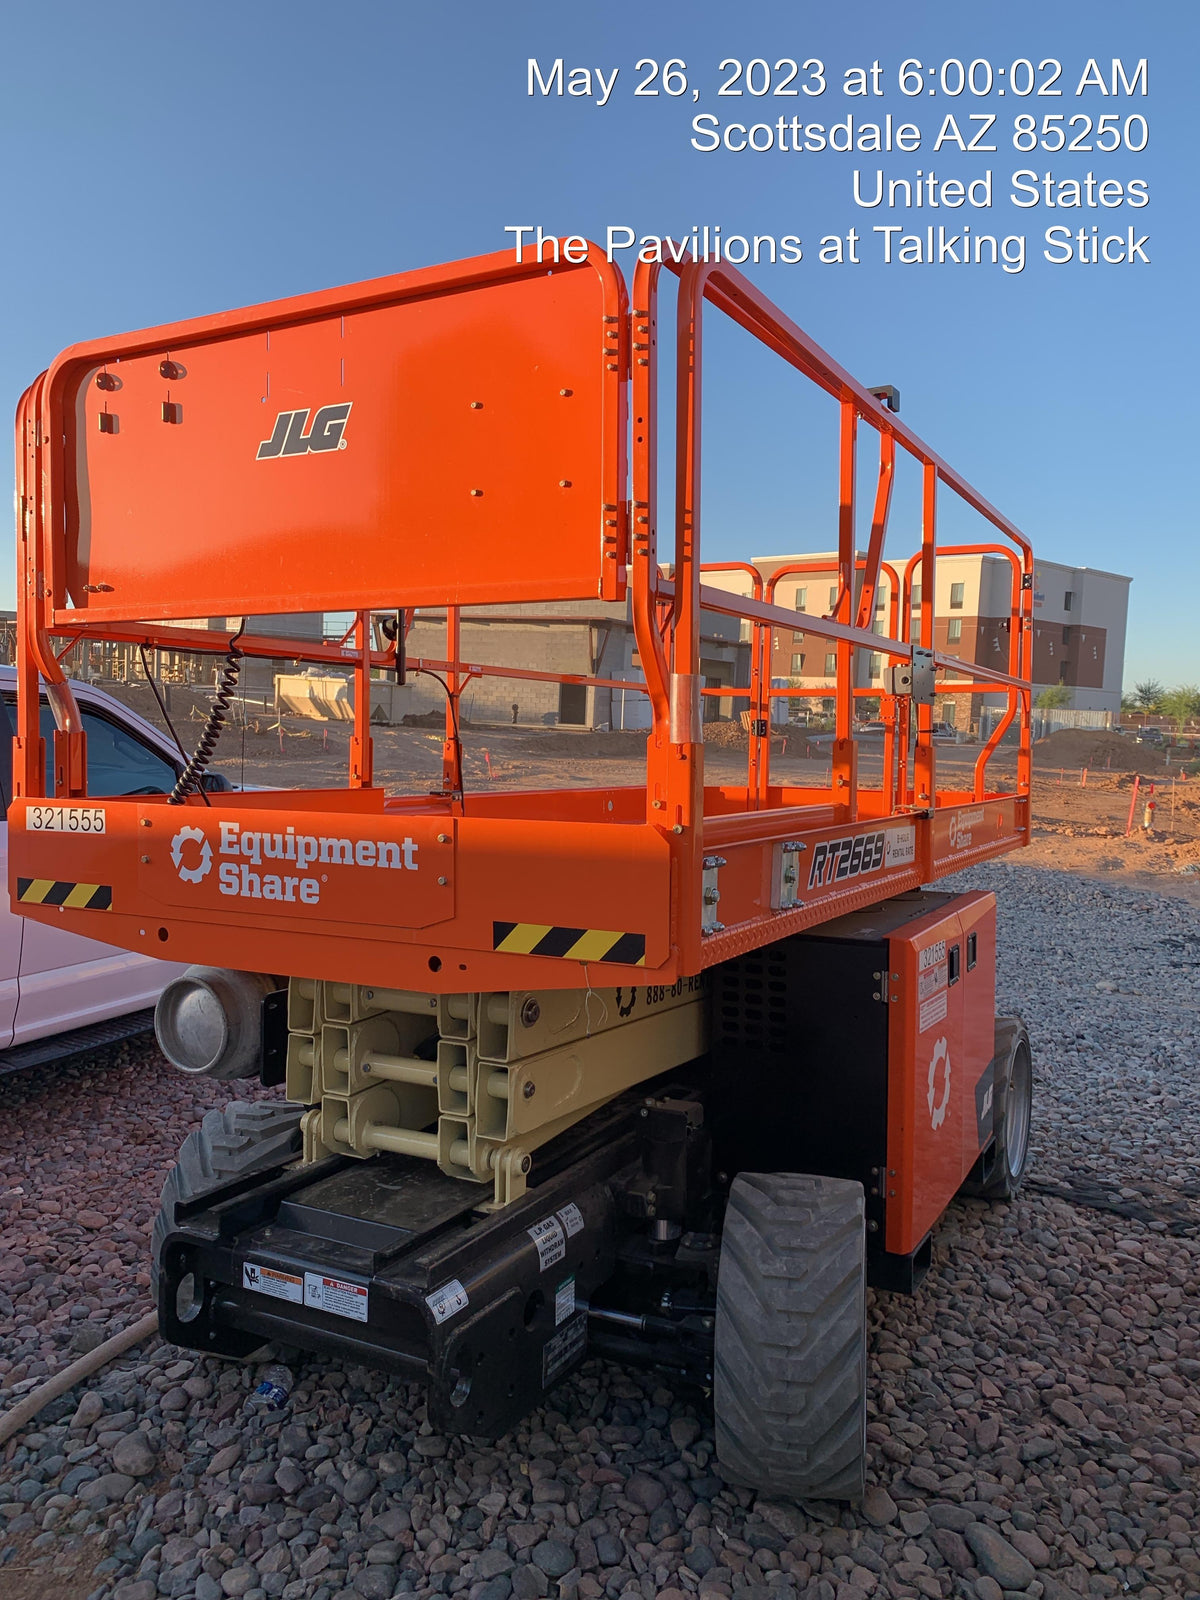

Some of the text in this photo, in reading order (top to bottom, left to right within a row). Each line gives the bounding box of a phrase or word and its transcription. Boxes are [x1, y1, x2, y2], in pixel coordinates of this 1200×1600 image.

[256, 401, 353, 461] JLG
[32, 806, 105, 831] 321555
[218, 821, 419, 870] Equipment
[807, 829, 886, 891] RT2669
[218, 863, 321, 904] Share
[336, 1282, 358, 1294] DANGER
